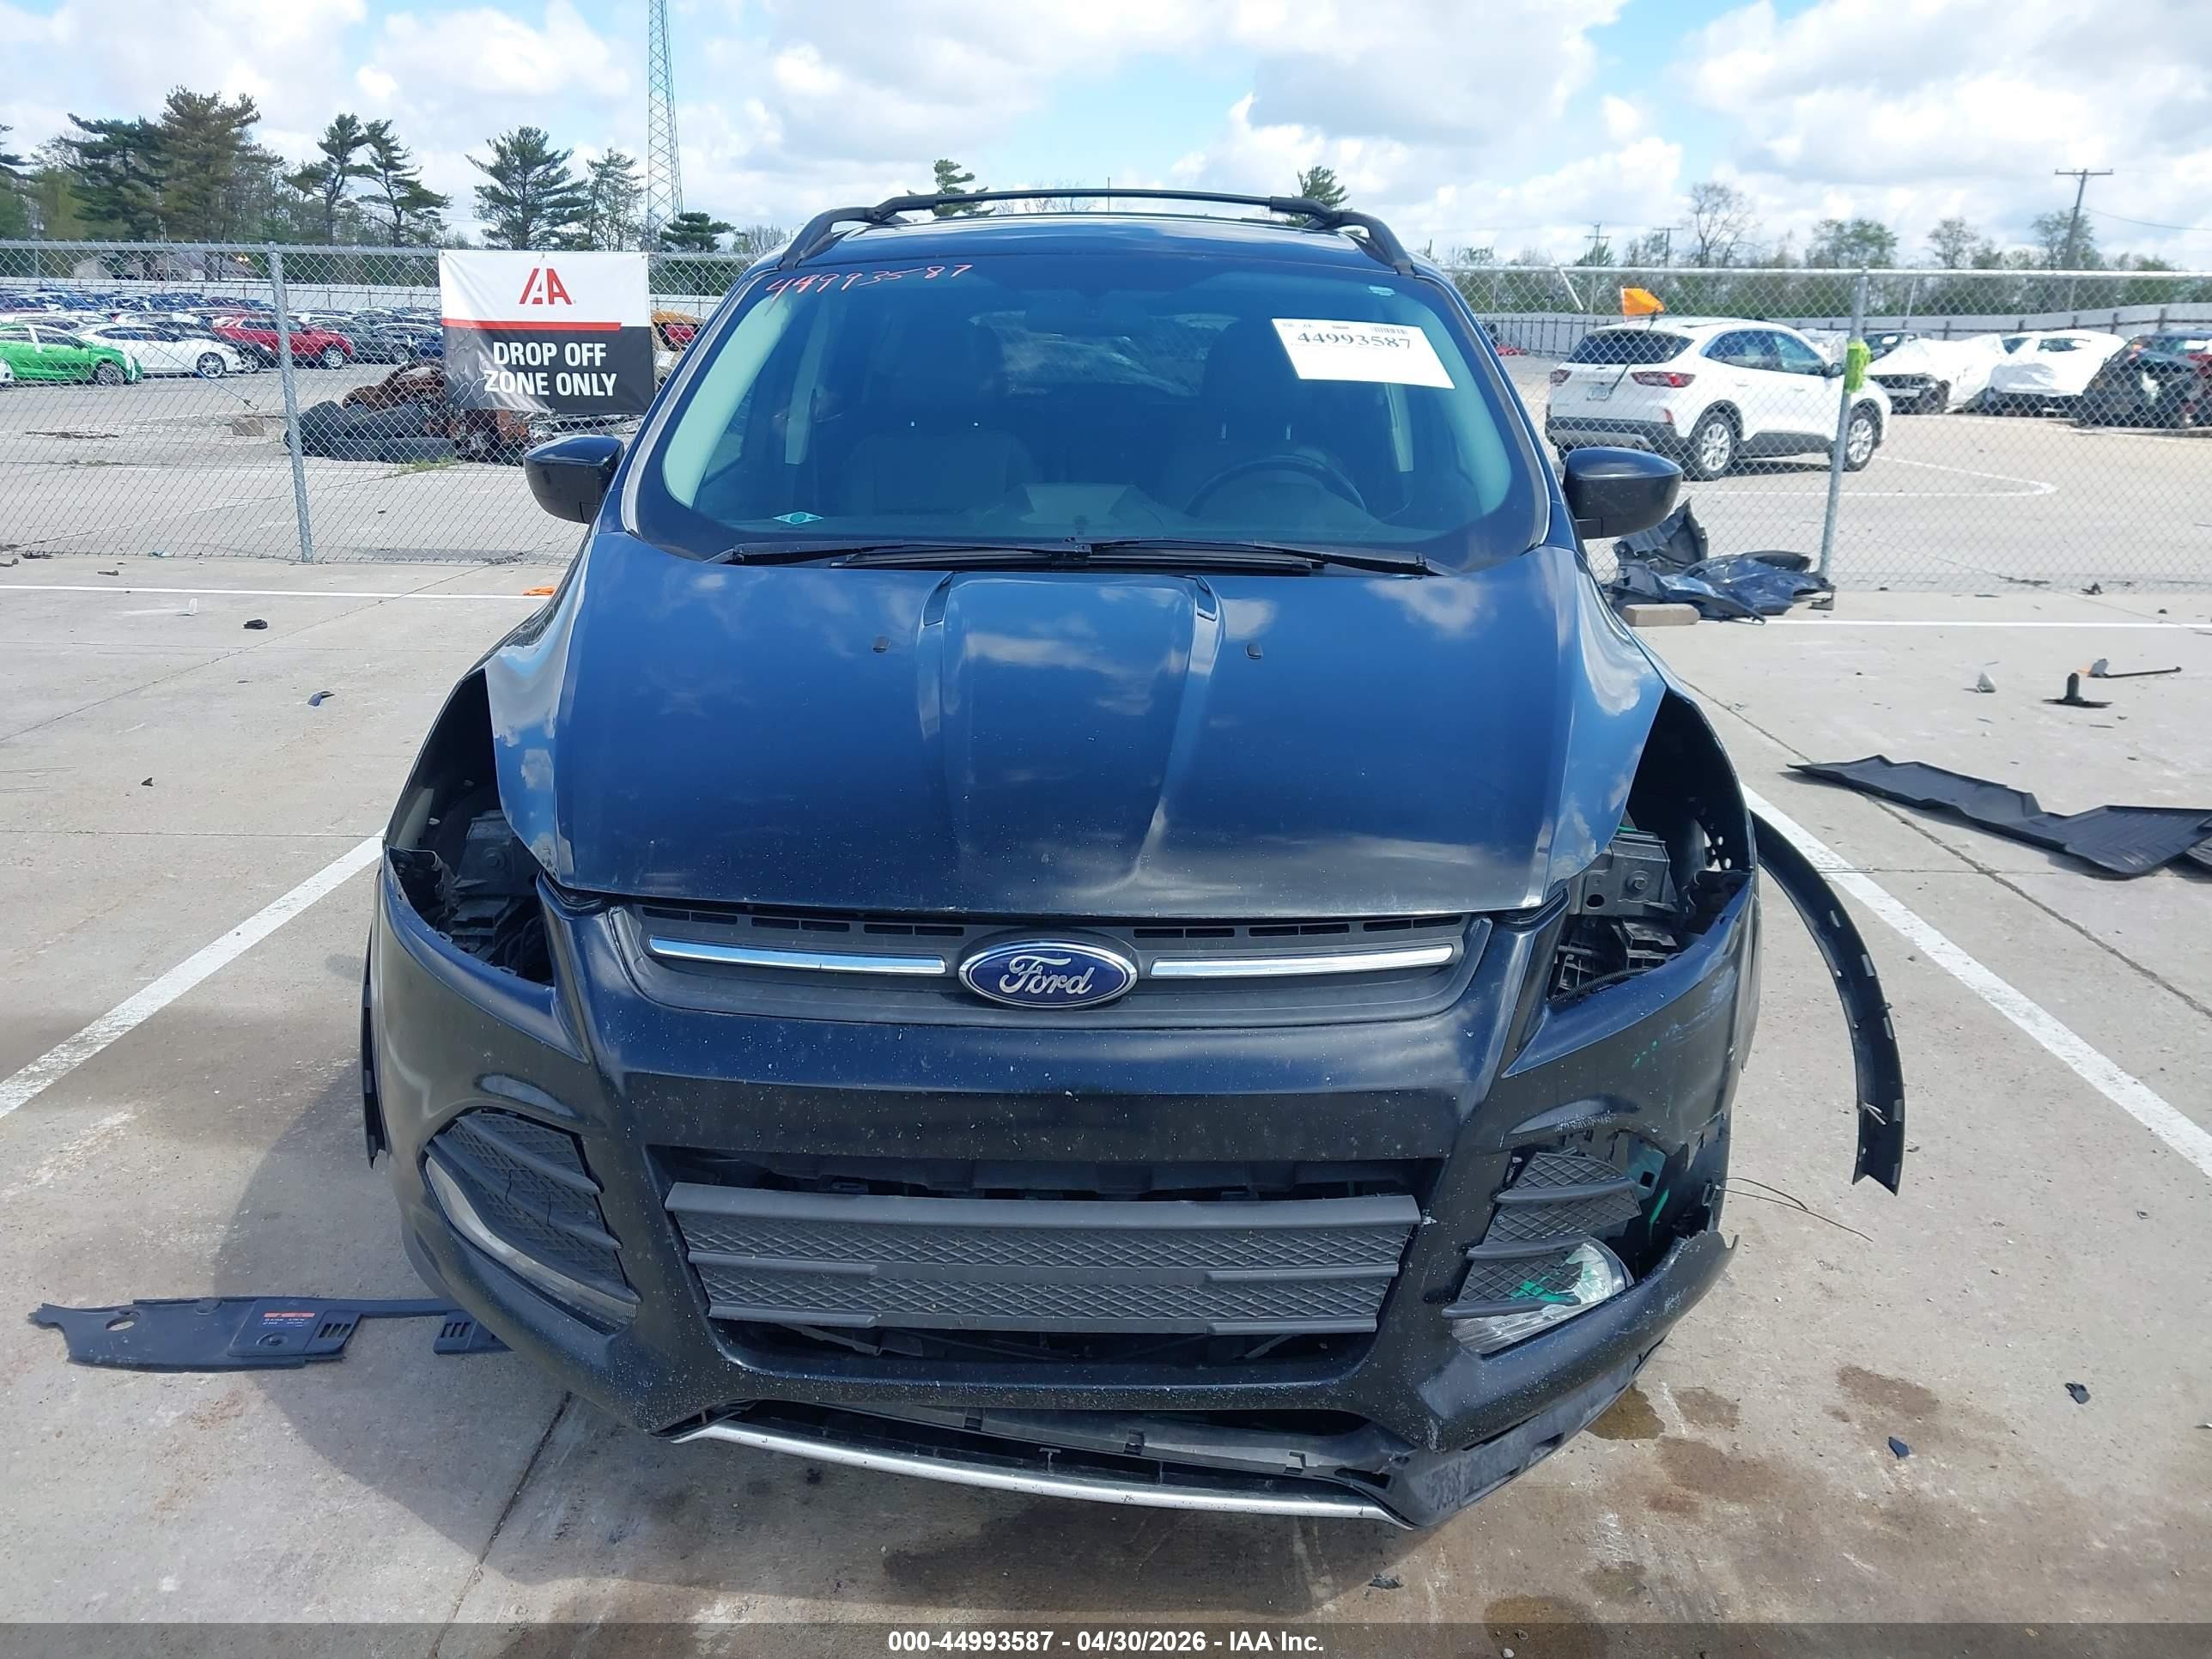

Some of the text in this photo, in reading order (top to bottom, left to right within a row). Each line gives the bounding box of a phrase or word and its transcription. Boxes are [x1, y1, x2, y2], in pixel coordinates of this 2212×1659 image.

[1297, 331, 1411, 349] 44993587
[493, 342, 607, 367] DROP OFF
[483, 370, 617, 397] ZONE ONLY
[999, 955, 1095, 994] Ford
